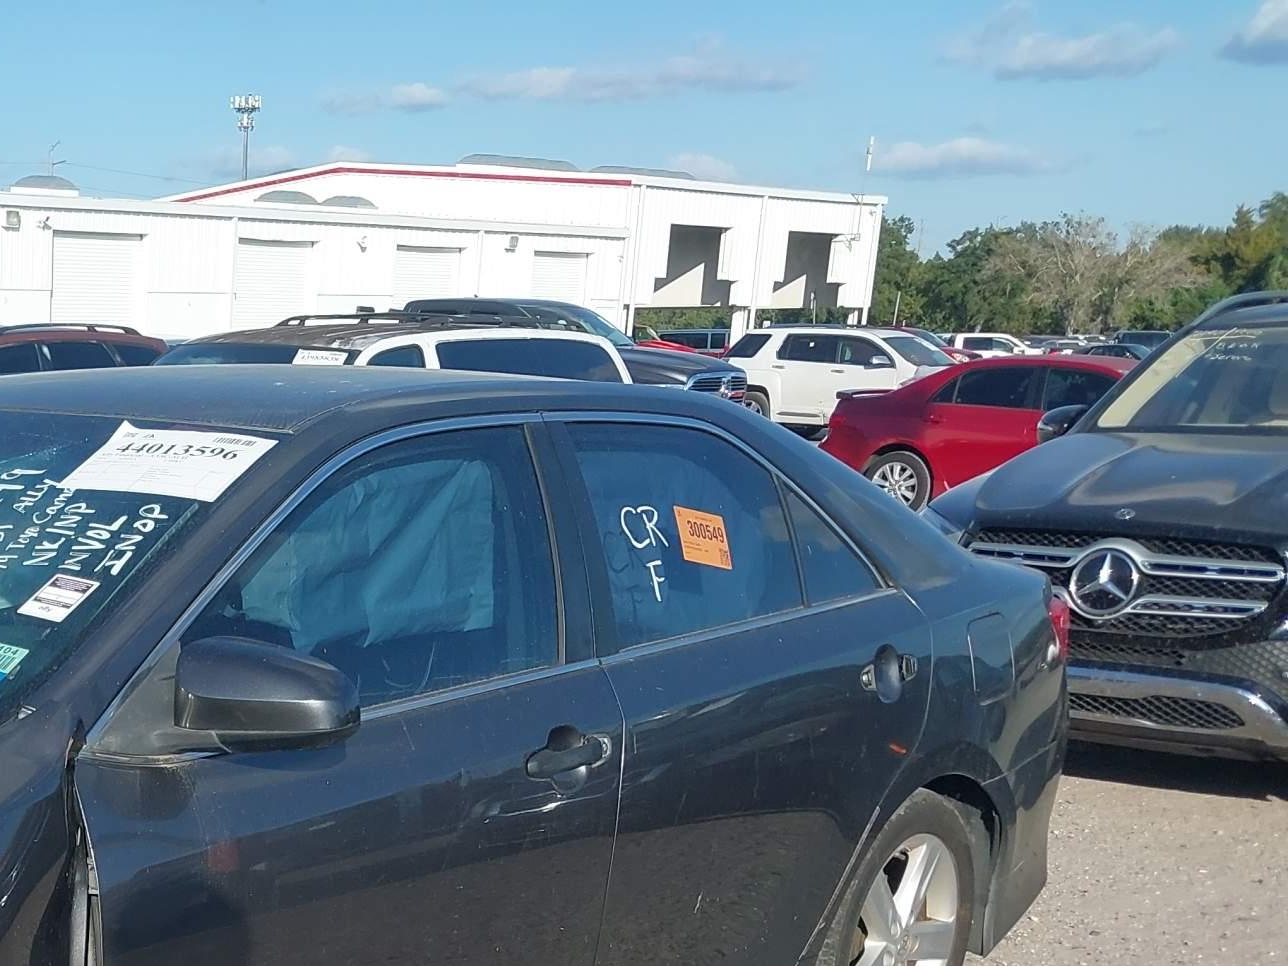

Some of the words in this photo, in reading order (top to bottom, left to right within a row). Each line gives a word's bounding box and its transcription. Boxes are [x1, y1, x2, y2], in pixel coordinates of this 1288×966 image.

[115, 440, 240, 461] 44013596
[94, 504, 168, 576] INOP
[620, 505, 669, 549] CR
[686, 519, 725, 544] 300549
[646, 559, 665, 602] F
